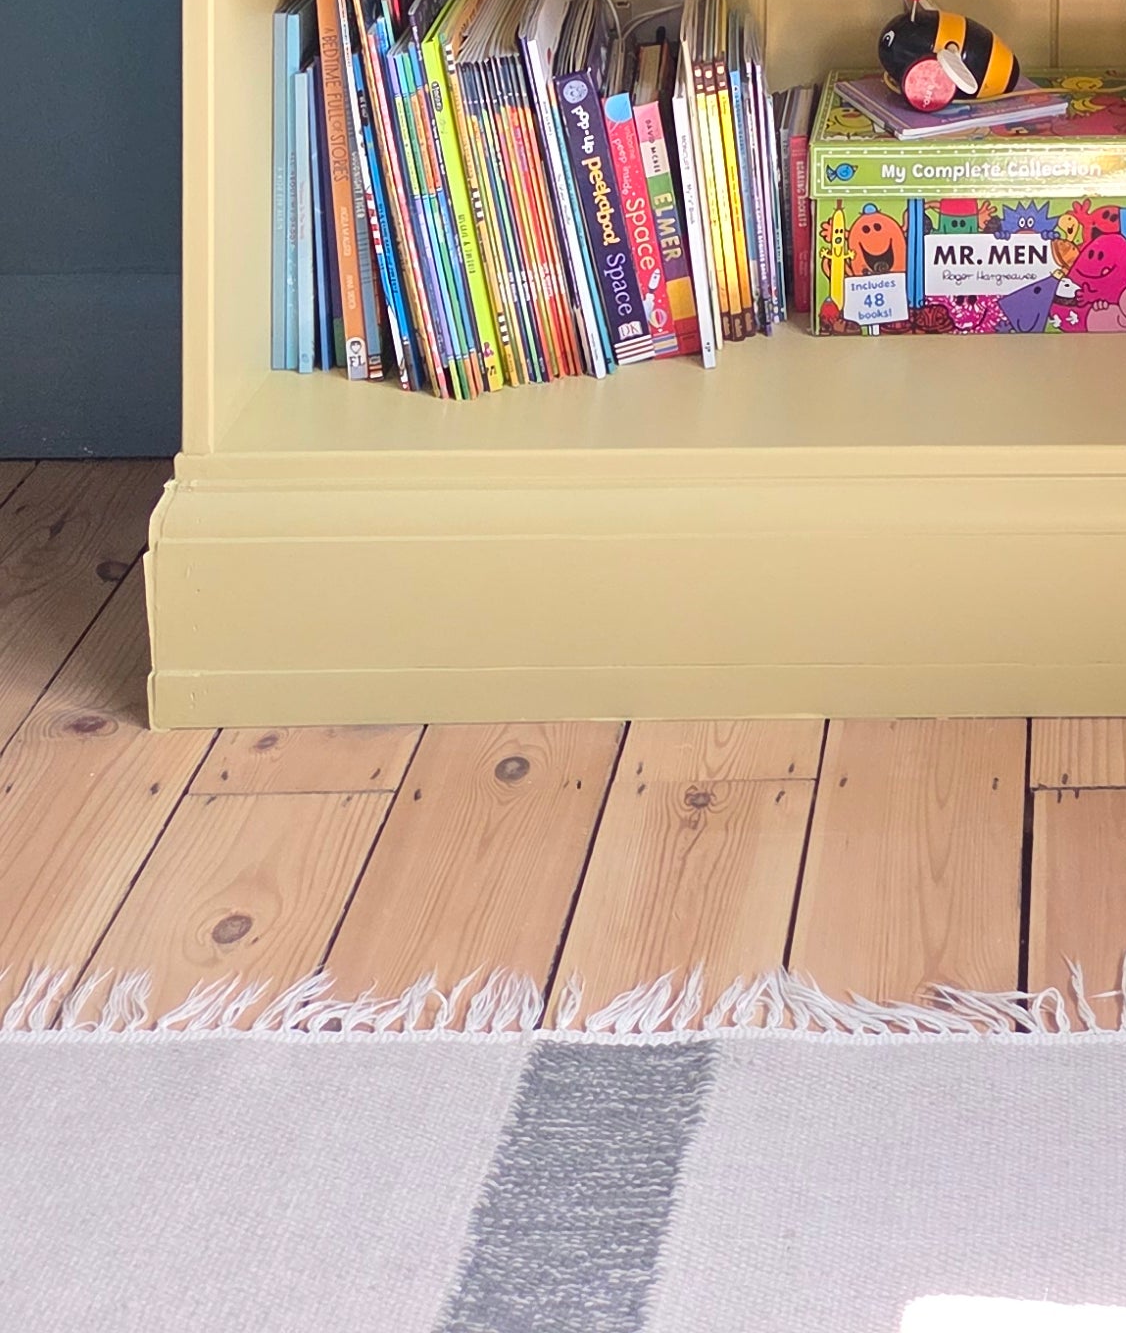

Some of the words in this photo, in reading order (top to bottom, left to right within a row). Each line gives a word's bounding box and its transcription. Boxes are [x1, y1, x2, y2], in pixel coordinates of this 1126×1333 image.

[322, 35, 341, 88] BEDTIME
[327, 92, 343, 121] FULL
[571, 105, 595, 155] pop-up
[645, 119, 656, 144] DAVID
[330, 134, 349, 183] STORIES
[351, 151, 364, 195] GOODNIGHT
[613, 138, 628, 163] peep
[621, 165, 633, 196] inside
[650, 146, 661, 173] MCKEE
[881, 163, 906, 183] My
[912, 162, 1002, 181] Complete
[1008, 161, 1102, 179] Collection
[796, 160, 806, 194] ROARING
[355, 196, 366, 219] TIGER
[582, 156, 621, 246] peekaboo!
[797, 195, 808, 227] ROCKETS
[625, 197, 656, 271] Space
[653, 192, 681, 262] ELMER
[933, 245, 983, 265] MR.
[988, 244, 1049, 265] MEN
[603, 252, 633, 317] Space
[851, 278, 896, 291] Includes
[942, 272, 974, 285] Roger
[976, 272, 1037, 285] Hargreaves
[858, 308, 893, 320] books!
[864, 292, 885, 308] 48
[620, 323, 641, 338] DK
